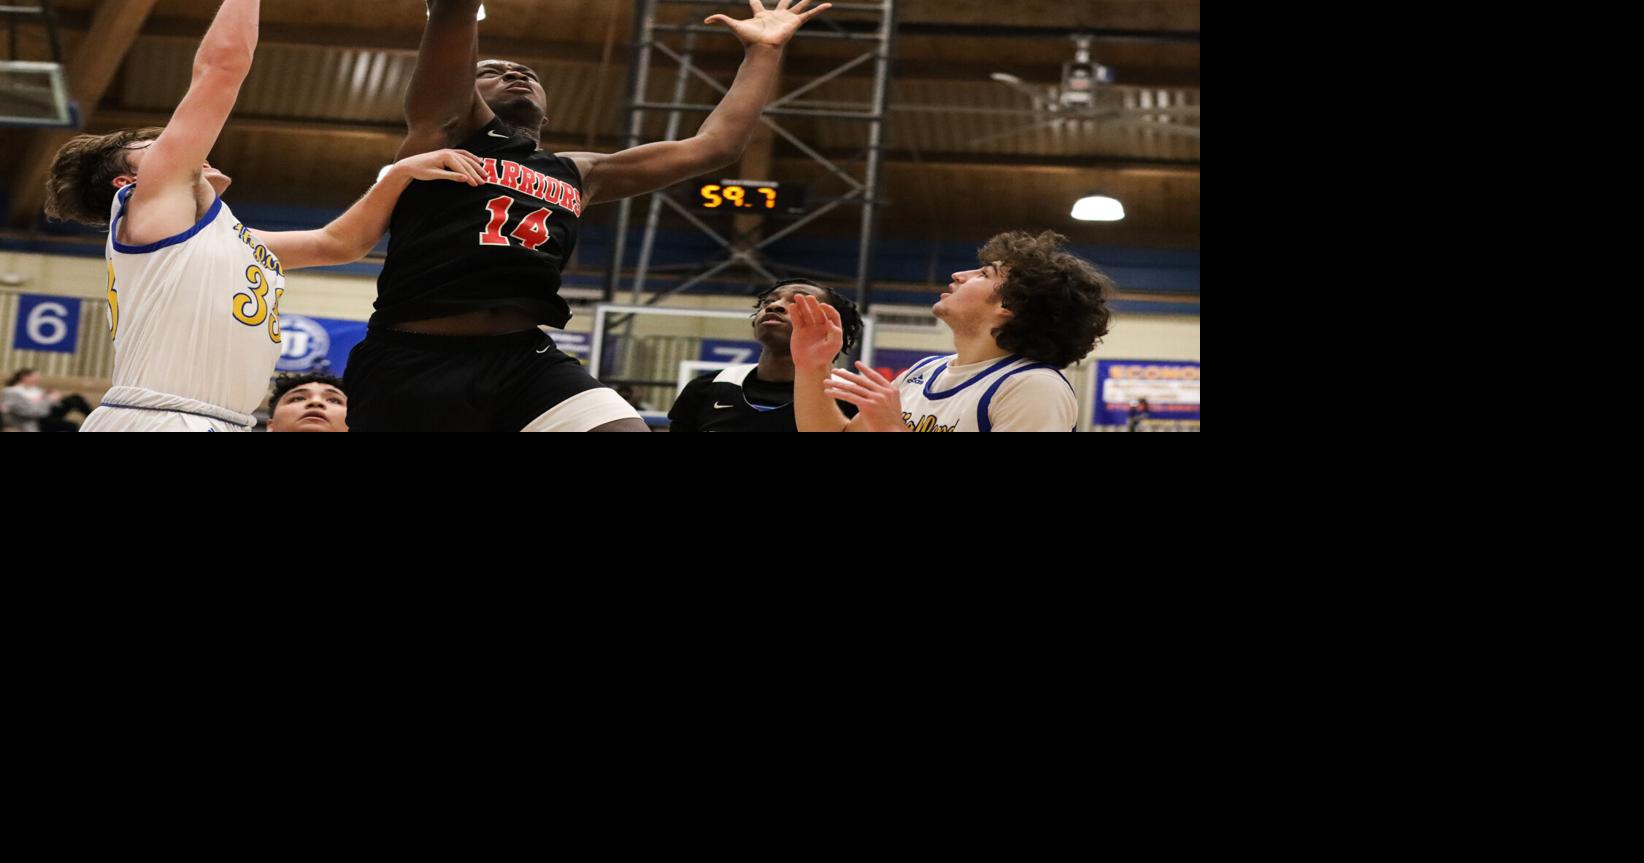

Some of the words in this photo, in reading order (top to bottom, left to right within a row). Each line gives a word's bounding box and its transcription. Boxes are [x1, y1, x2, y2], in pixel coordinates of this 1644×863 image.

[481, 157, 581, 218] ARRIORS
[479, 195, 553, 251] 14
[26, 302, 68, 345] 6
